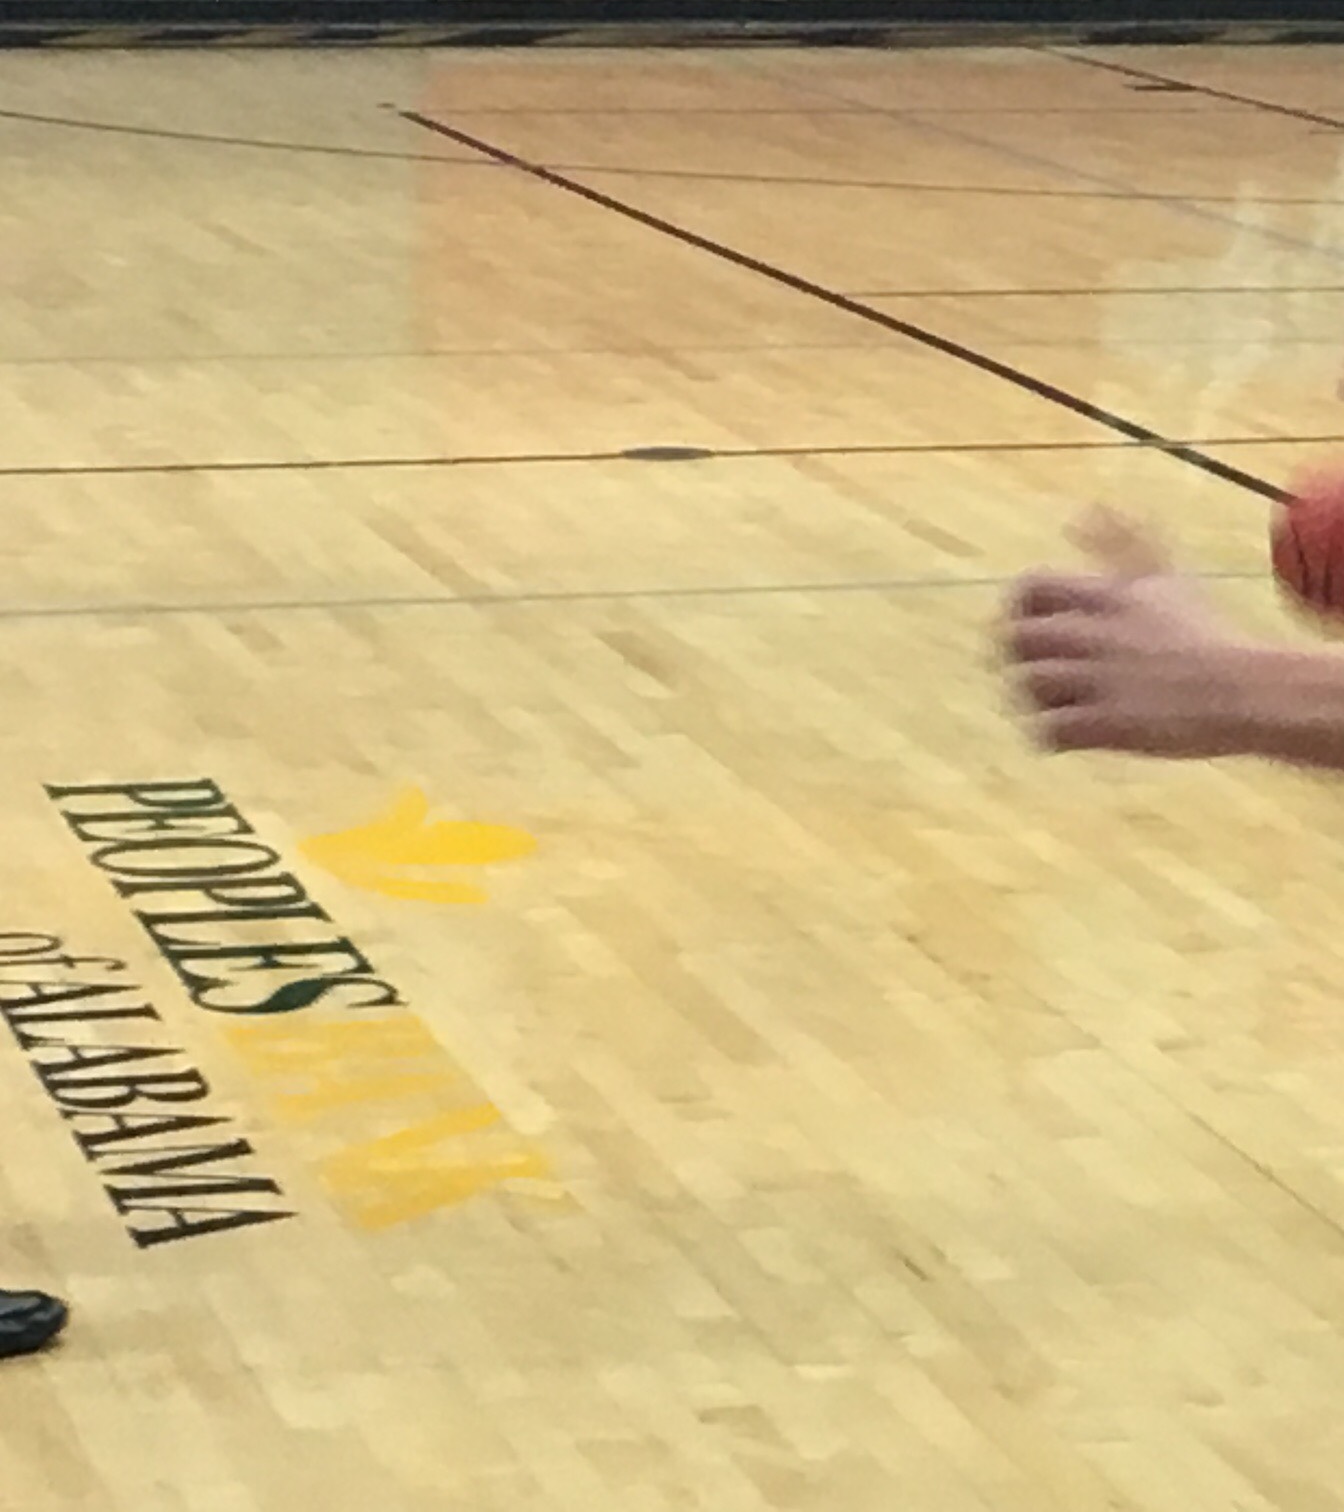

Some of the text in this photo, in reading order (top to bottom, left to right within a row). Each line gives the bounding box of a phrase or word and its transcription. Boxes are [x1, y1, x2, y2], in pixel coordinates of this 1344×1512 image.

[40, 777, 410, 1014] PEOPLES
[0, 932, 300, 1250] of ALABAMA
